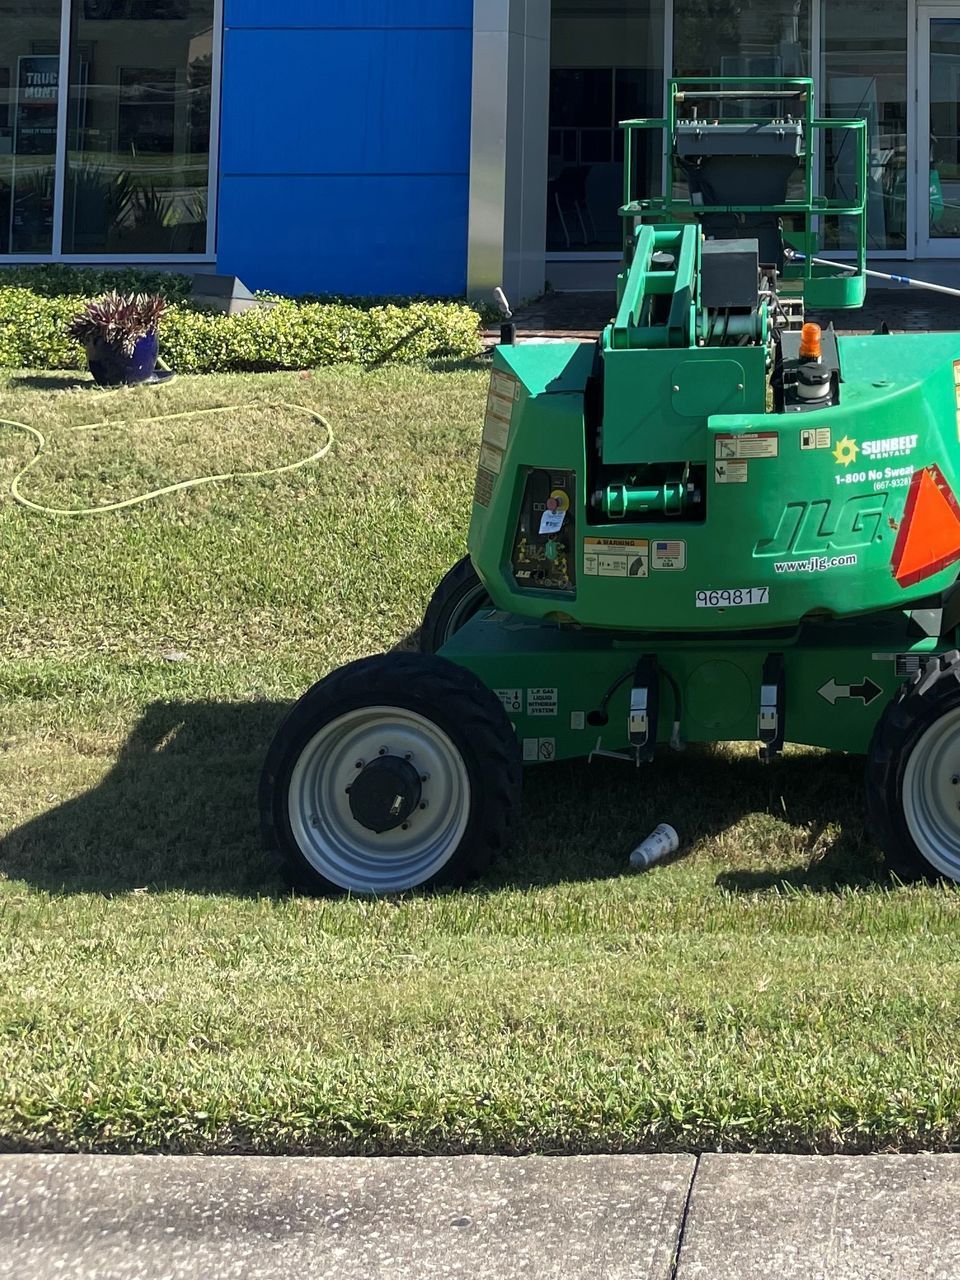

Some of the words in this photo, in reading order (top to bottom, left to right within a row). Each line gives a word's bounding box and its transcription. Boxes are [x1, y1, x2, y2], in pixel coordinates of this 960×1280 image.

[26, 72, 59, 84] TRUC
[24, 86, 58, 98] MONT
[861, 434, 918, 455] SUNBELT
[869, 448, 911, 460] RENTALS
[835, 472, 866, 485] 1-800
[868, 469, 883, 481] No
[884, 465, 914, 478] Sweat
[753, 492, 888, 557] JLG
[775, 554, 857, 572] www.jlg.com
[697, 587, 768, 606] 969817
